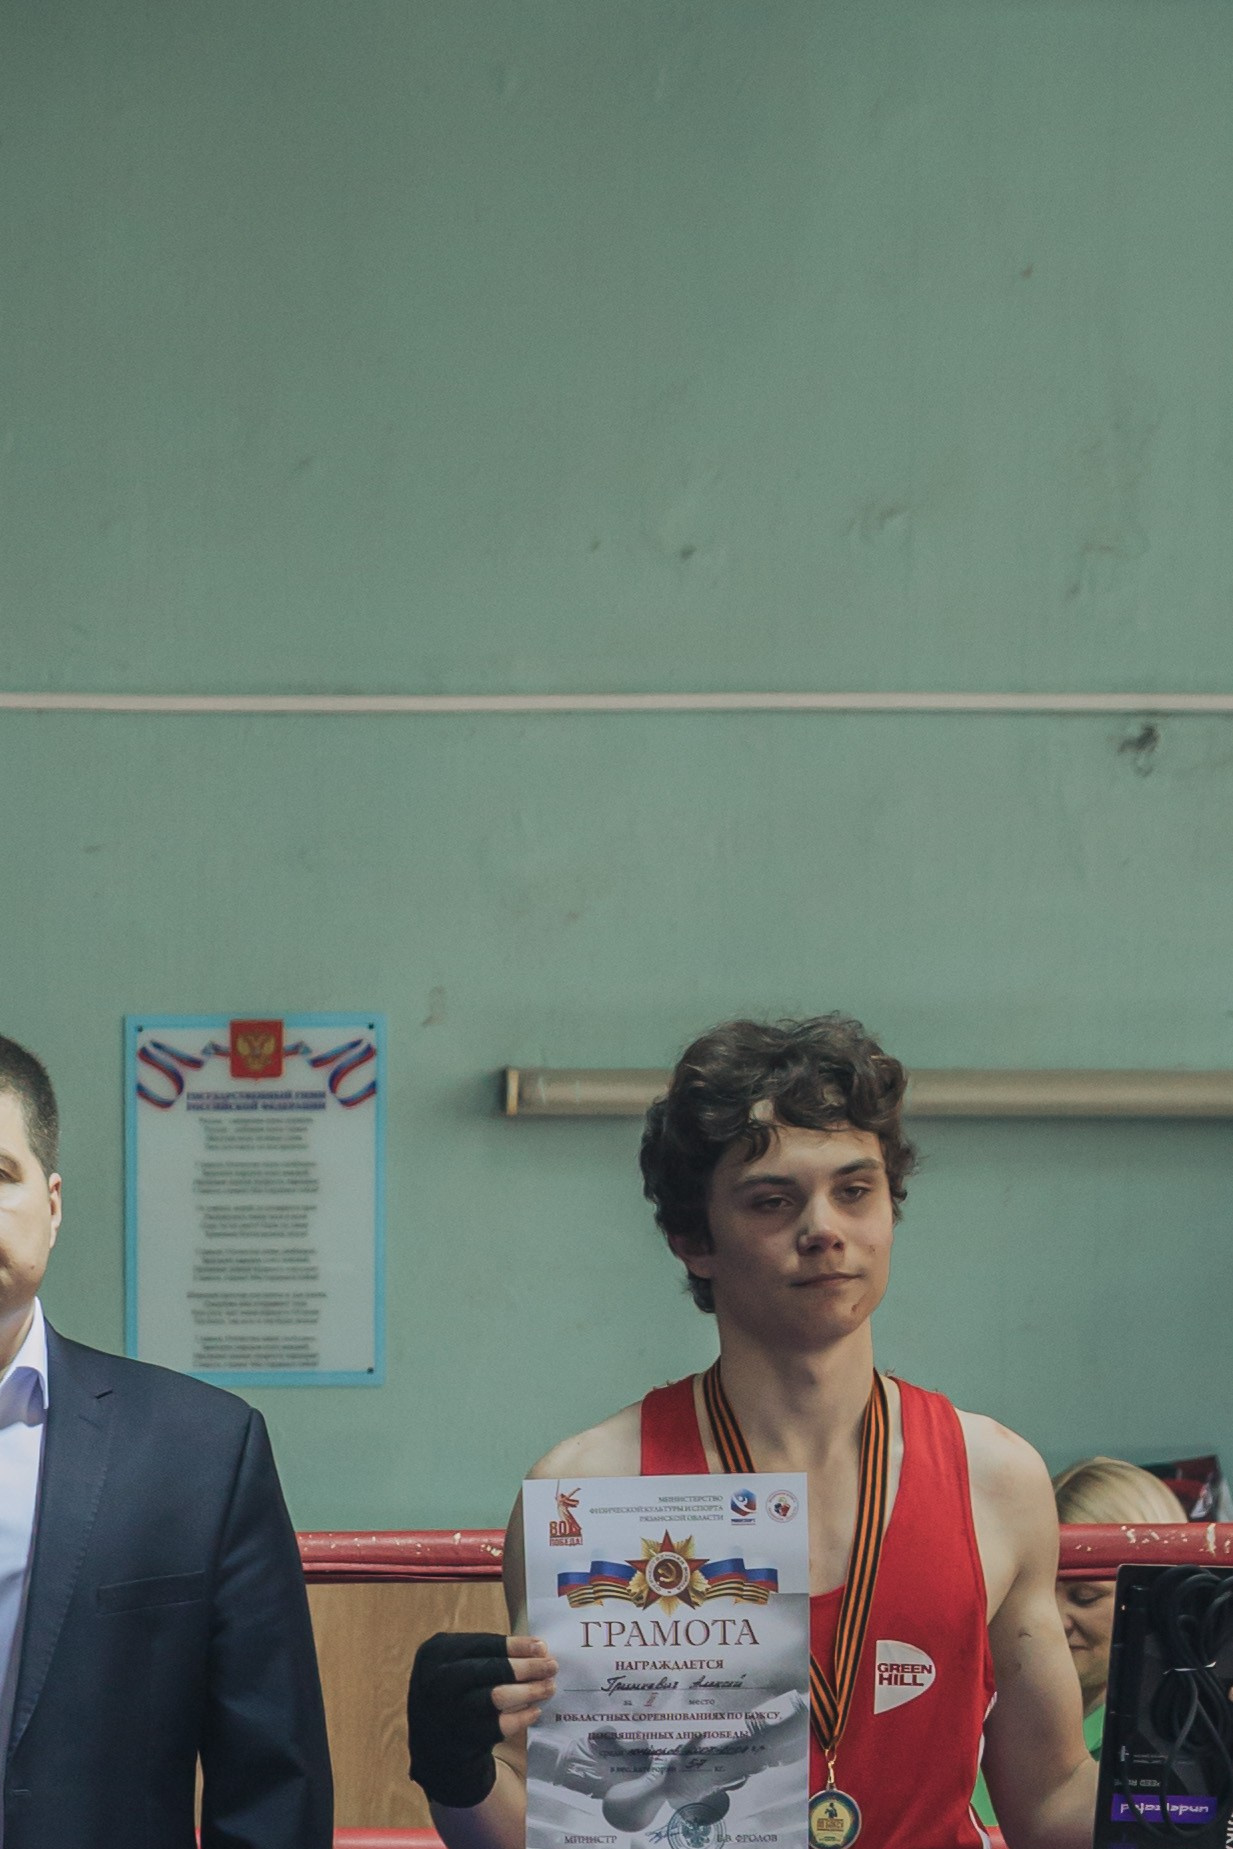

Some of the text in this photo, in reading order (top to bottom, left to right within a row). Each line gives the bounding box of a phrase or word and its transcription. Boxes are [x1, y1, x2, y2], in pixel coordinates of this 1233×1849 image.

[580, 1618, 760, 1648] ГРАМОТА
[614, 1659, 724, 1671] НАГРАЖДАЕТСЯ
[877, 1663, 932, 1674] GREEN
[878, 1674, 924, 1687] HILL
[562, 1713, 631, 1722] ОБЛАСТНЫХ
[631, 1712, 727, 1721] СОРЕВНОВАНИЯХ
[727, 1712, 743, 1721] ПО
[564, 1835, 617, 1844] МИНИСТР
